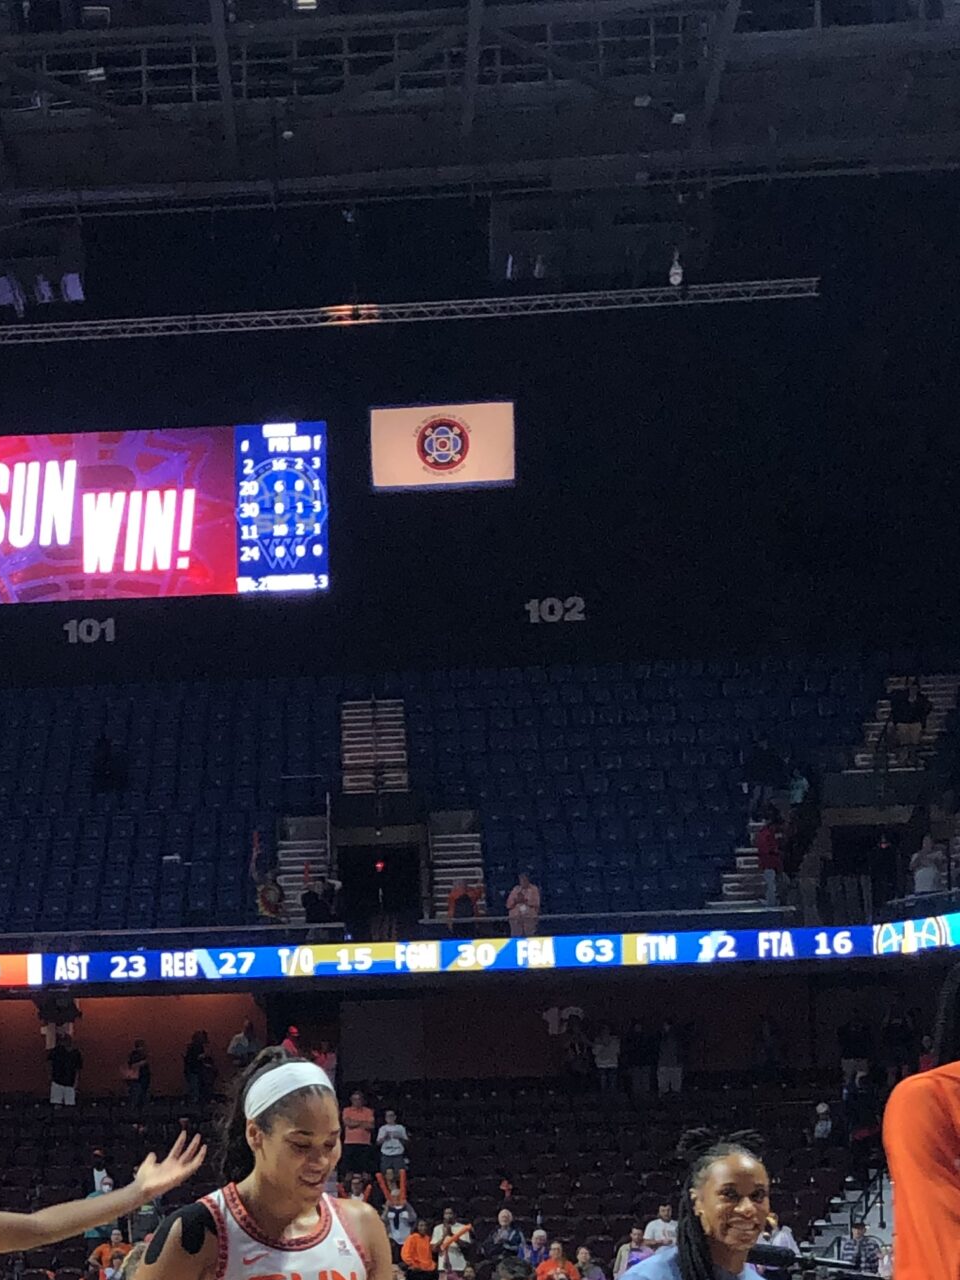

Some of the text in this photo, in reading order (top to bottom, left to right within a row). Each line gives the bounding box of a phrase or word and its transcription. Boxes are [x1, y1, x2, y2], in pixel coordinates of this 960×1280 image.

[82, 488, 196, 574] WIN!
[525, 596, 586, 623] 102
[63, 617, 116, 644] 101
[54, 955, 89, 981] AST
[110, 956, 146, 978] 23
[161, 952, 198, 977] REB
[218, 952, 256, 974] 27
[336, 948, 373, 971] 15
[457, 943, 496, 967] 30
[575, 939, 614, 963] 63
[636, 935, 677, 961] FTM
[698, 936, 737, 959] 12
[758, 931, 794, 957] FTA
[815, 931, 853, 955] 16
